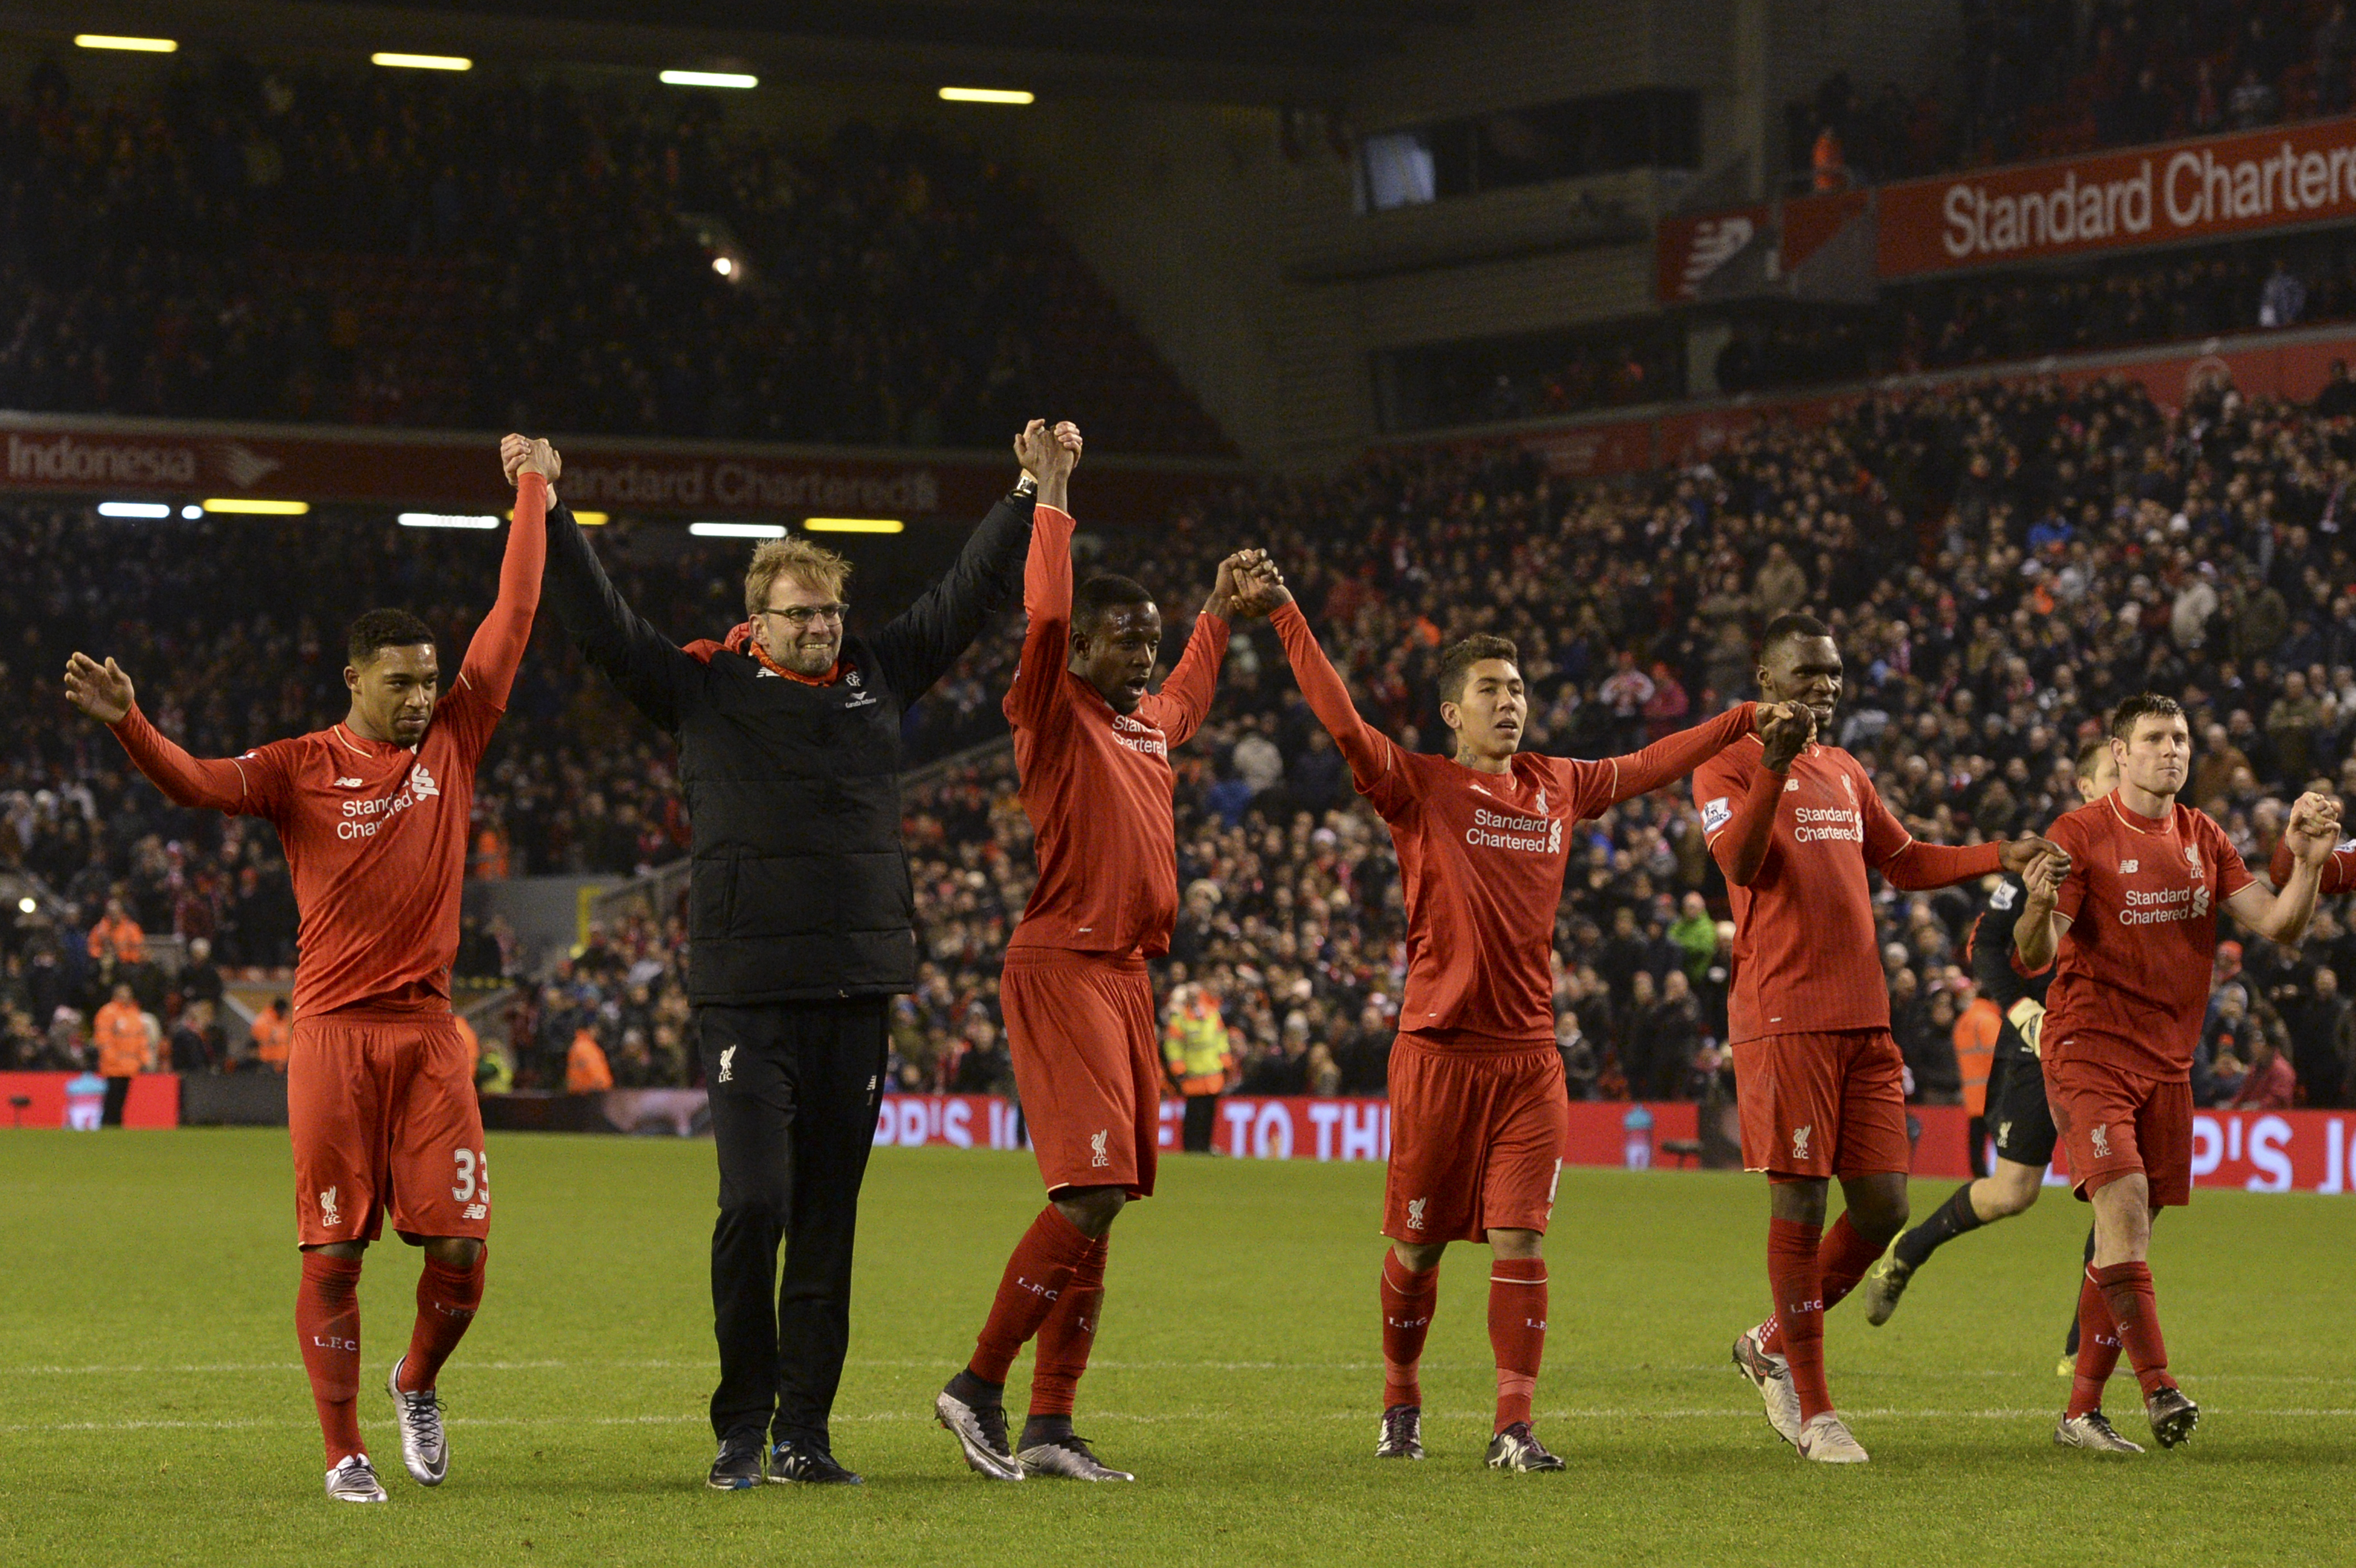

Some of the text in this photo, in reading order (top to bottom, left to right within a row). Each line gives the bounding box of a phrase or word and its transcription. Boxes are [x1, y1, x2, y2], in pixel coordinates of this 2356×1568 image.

[1943, 158, 2153, 257] Standard
[8, 434, 195, 482] Indonesia
[1474, 808, 1548, 833] Standard
[1795, 806, 1854, 823] Standard
[1466, 828, 1546, 853] Chartered
[1794, 825, 1858, 843] Chartered
[2126, 885, 2191, 906] Standard
[2119, 905, 2189, 925] Chartered
[1222, 1100, 1293, 1161] TO
[1307, 1102, 1391, 1162] TH
